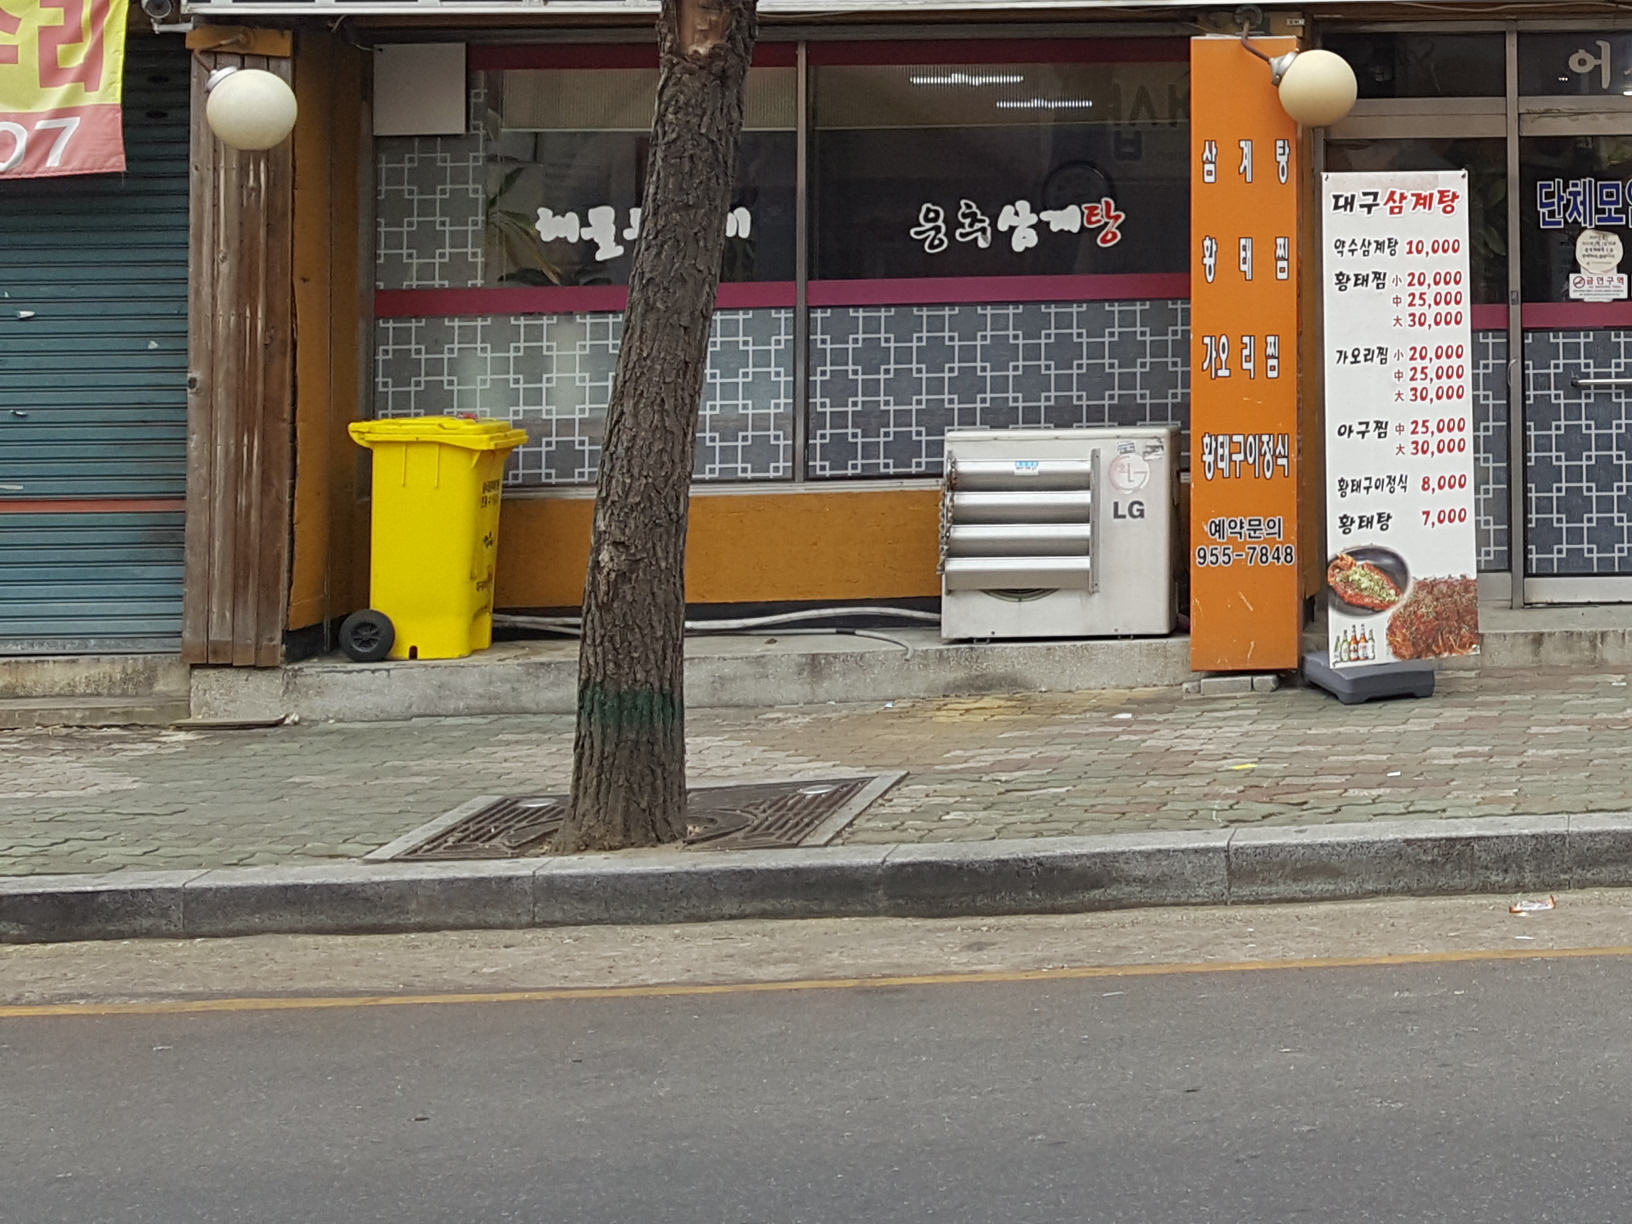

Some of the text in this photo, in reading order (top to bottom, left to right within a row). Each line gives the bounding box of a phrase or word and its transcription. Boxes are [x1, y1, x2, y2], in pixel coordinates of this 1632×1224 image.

[1202, 138, 1290, 184] 삼계탕
[1331, 189, 1460, 216] 대구삼계탕
[1334, 237, 1461, 258] 약수삼계탕 10,000
[1202, 235, 1289, 283] 황태찜
[1334, 270, 1462, 292] 황태찜 小 20,000
[1587, 277, 1624, 286] 금연구역
[1392, 291, 1463, 310] 中 25,000
[1392, 311, 1463, 330] 大 30,000
[1202, 333, 1280, 380] 가오리찜
[1335, 344, 1464, 366] 가오리찜 小 20,000
[1394, 364, 1465, 385] 中 25,000
[1394, 384, 1465, 405] 大 30,000
[1337, 417, 1466, 440] 아구찜 中 25,000
[1202, 432, 1289, 481] 황태구이정식
[1395, 438, 1466, 458] 大 30,000
[1337, 474, 1467, 498] 황태구이정식 8,000
[1113, 500, 1145, 519] LG
[1208, 516, 1284, 541] 예약문의
[1338, 507, 1468, 535] 황태탕 7,000
[1196, 544, 1295, 568] 955-7848
